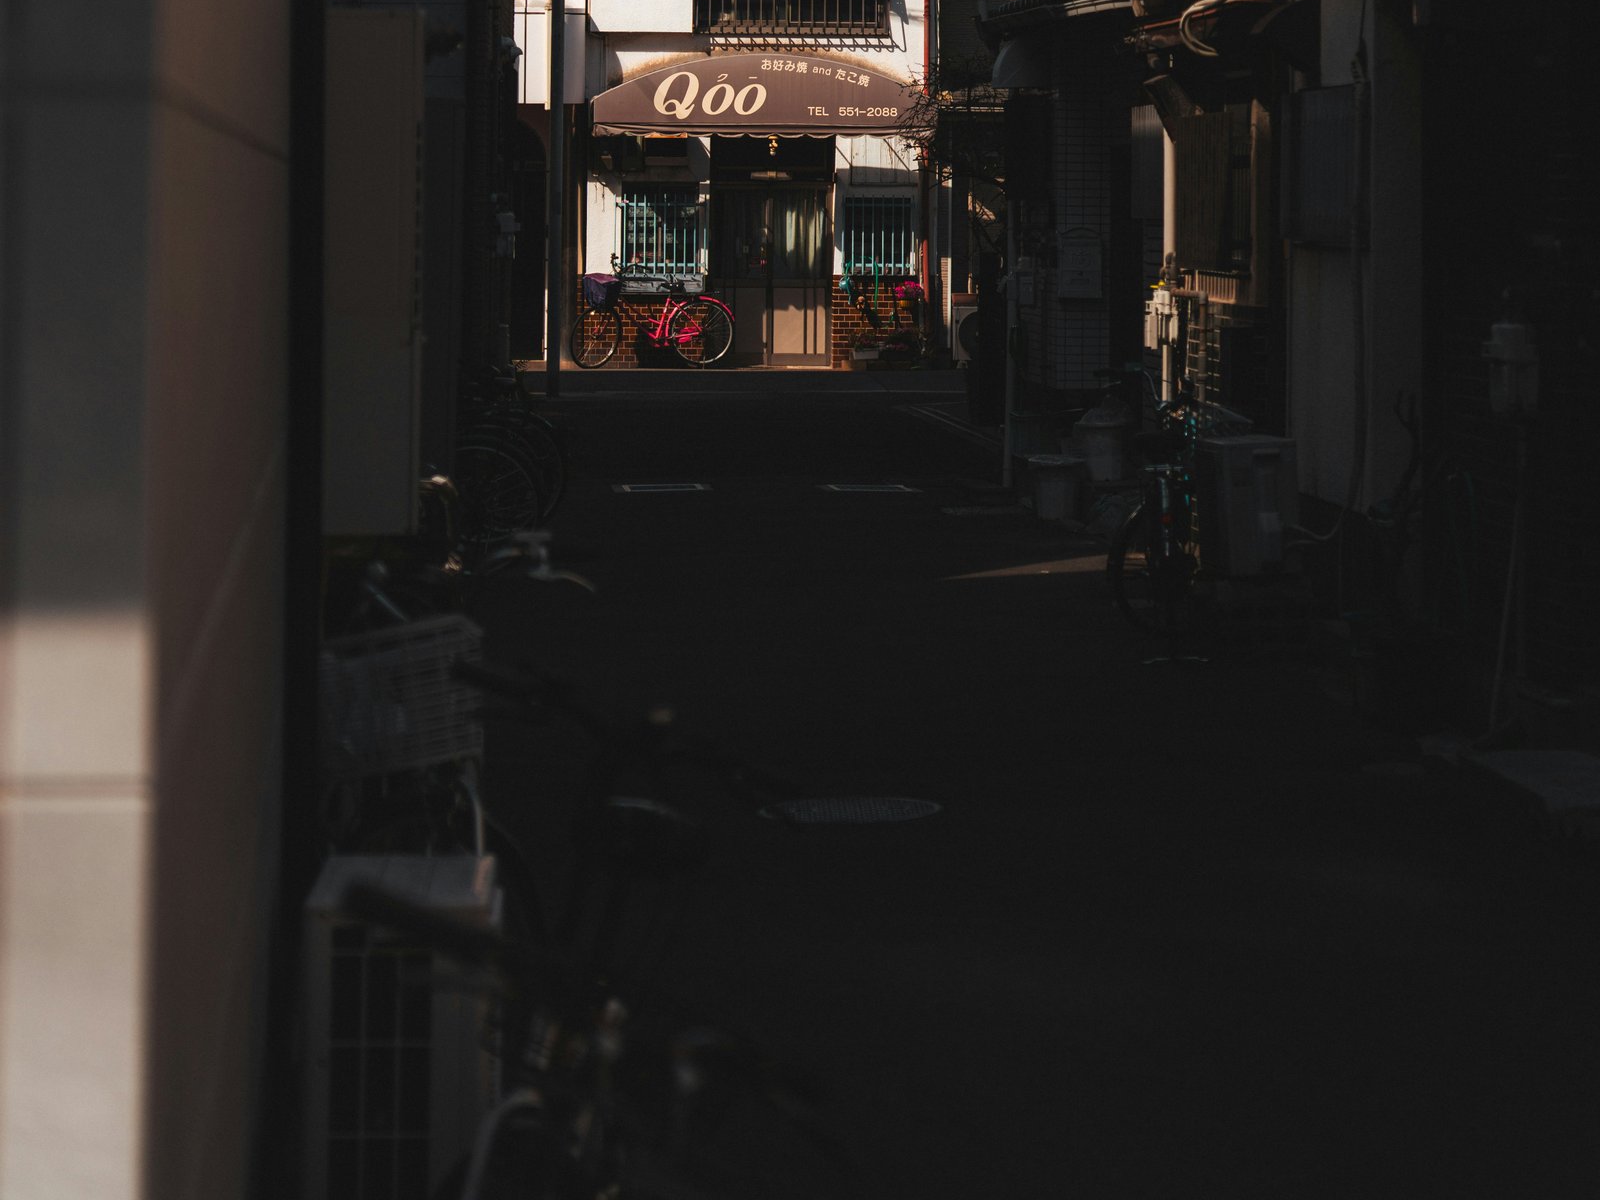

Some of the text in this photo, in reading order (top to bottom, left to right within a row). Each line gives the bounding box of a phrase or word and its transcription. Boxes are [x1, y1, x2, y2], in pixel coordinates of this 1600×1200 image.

[761, 58, 871, 88] お好み焼 and たこ焼
[807, 106, 898, 117] TEL 551-2088
